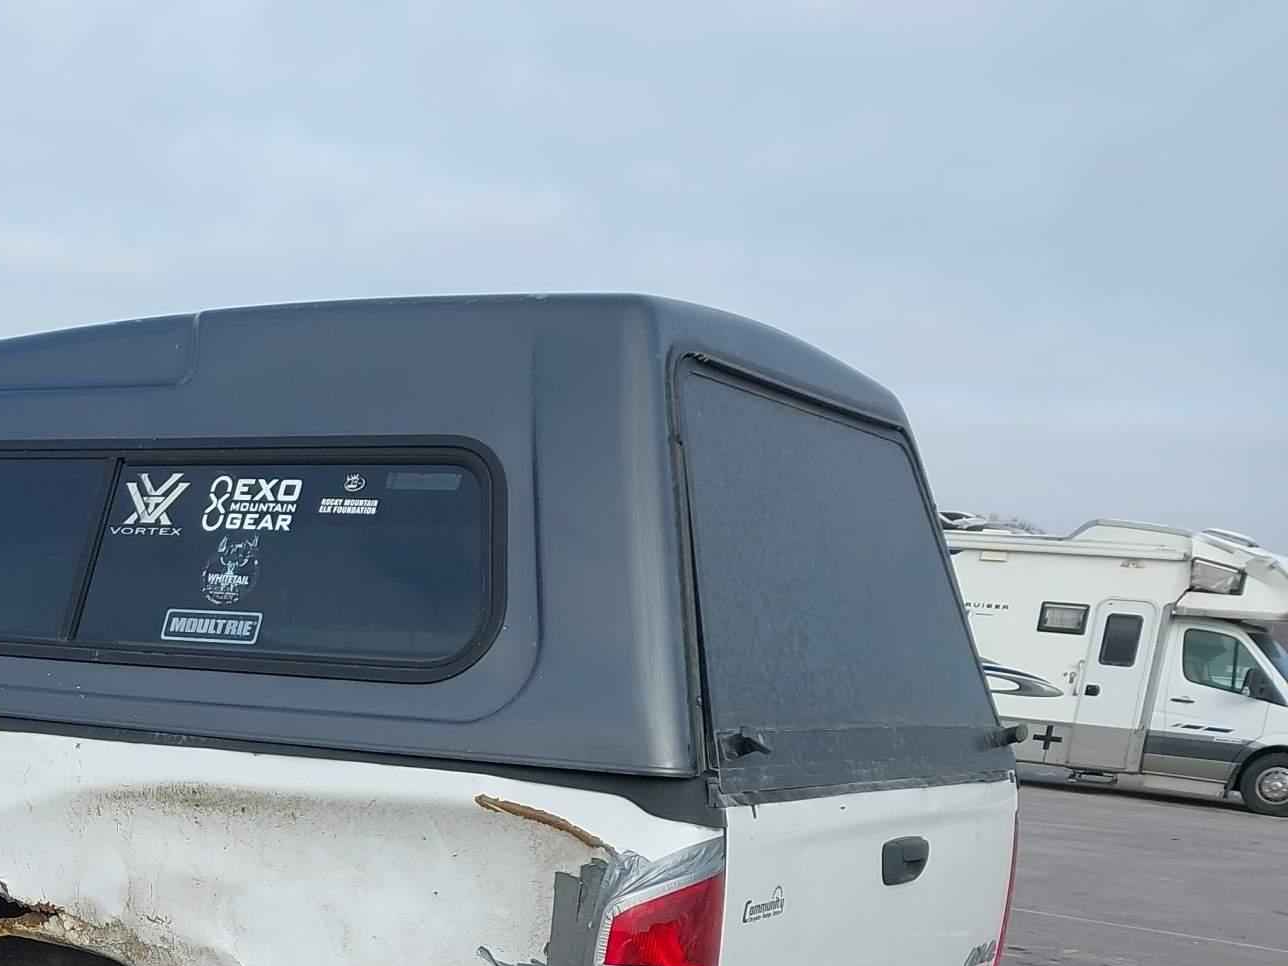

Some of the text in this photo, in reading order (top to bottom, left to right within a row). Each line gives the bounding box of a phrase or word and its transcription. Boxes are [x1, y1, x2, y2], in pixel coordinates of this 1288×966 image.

[233, 478, 303, 502] EXO
[230, 502, 297, 513] MOUNTAIN
[321, 498, 379, 507] ROCKY MOUNTAIN
[318, 505, 377, 515] ELK FOUNDATION
[225, 513, 293, 531] GEAR
[110, 526, 183, 536] VORTEX
[169, 617, 253, 636] MOULTRIE
